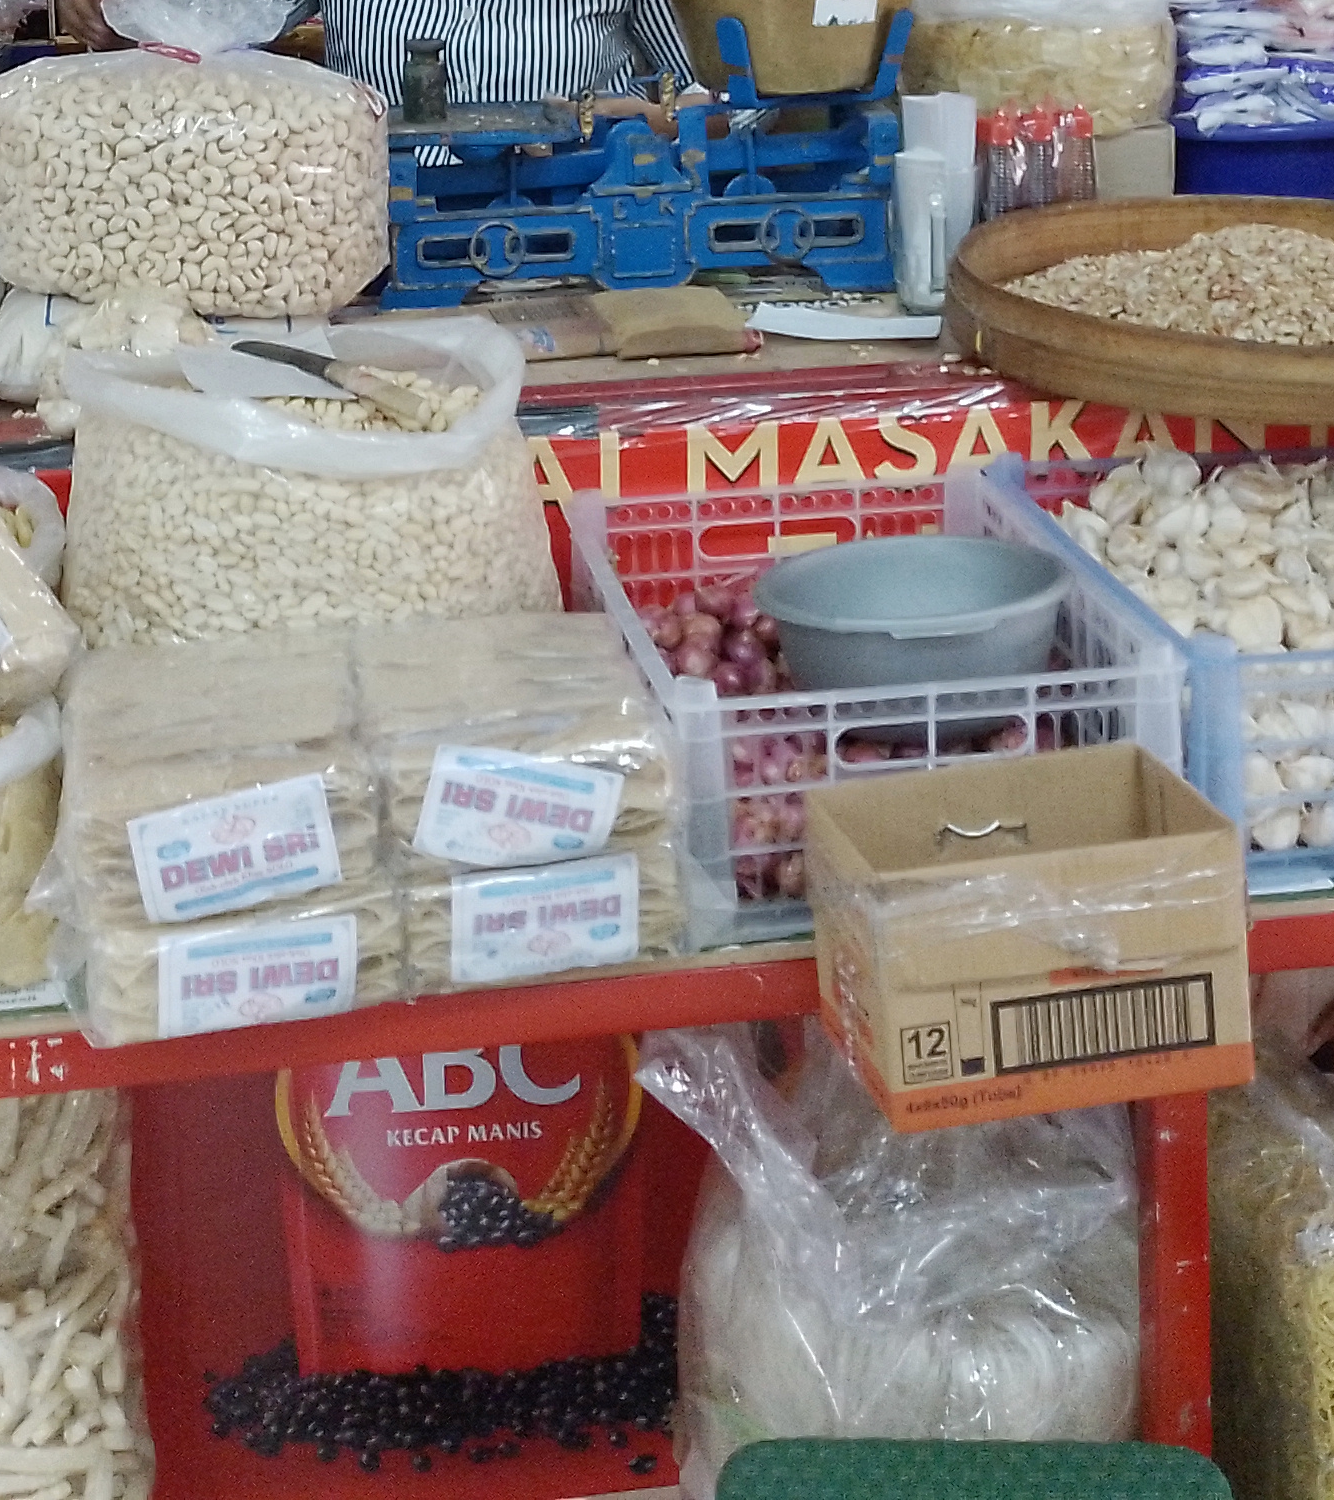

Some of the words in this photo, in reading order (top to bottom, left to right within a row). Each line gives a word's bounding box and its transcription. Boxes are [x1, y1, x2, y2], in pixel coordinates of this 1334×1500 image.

[440, 779, 497, 814] SRI
[506, 798, 595, 834] DEWI
[158, 842, 253, 894] DEWI
[263, 825, 321, 864] SRI
[472, 908, 528, 937] SRI
[537, 893, 622, 926] DEWI
[180, 968, 238, 1001] SRI
[250, 957, 340, 987] DEWI
[324, 1043, 581, 1119] ABC
[386, 1126, 461, 1149] KECAP
[466, 1119, 544, 1144] MANIS
